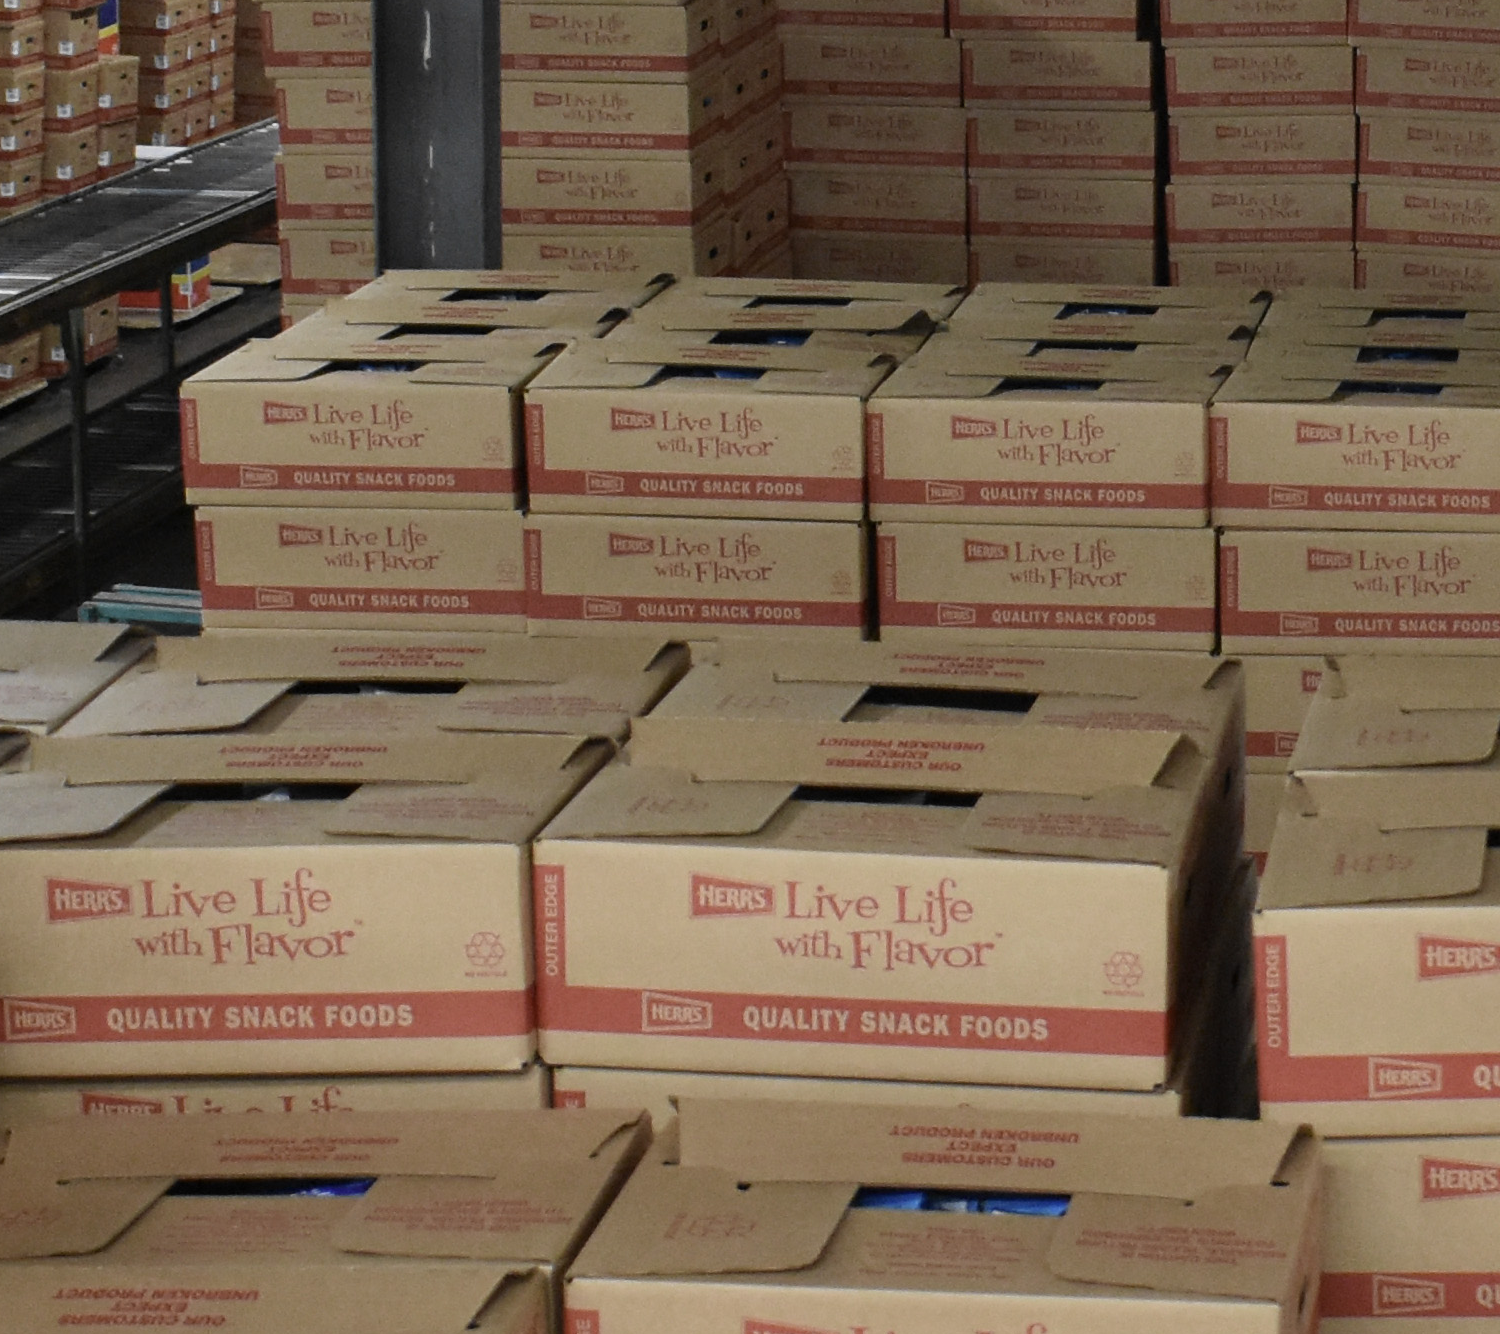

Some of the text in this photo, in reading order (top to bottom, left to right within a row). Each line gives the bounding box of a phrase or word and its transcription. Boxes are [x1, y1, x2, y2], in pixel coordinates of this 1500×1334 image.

[314, 404, 363, 425] Live
[371, 400, 412, 432] Life
[310, 429, 424, 451] with Flavor
[294, 472, 350, 485] QUALITY
[356, 472, 403, 486] SNACK
[408, 473, 455, 486] FOODS
[1359, 550, 1408, 570] Live
[1418, 547, 1460, 578] Life
[1353, 576, 1471, 597] with Flavor
[1335, 619, 1392, 632] QUALITY
[1399, 619, 1447, 632] SNACK
[1452, 620, 1500, 632] FOODS
[889, 1126, 1080, 1143] UNBROKEN PRODUCT
[947, 1141, 1017, 1152] EXPECT
[902, 1152, 1055, 1168] OUR CUSTOMERS
[52, 1288, 259, 1301] UNBROKEN PRODUCT
[111, 1301, 187, 1312] EXPECT
[58, 1314, 226, 1326] OUR CUSTOMERS
